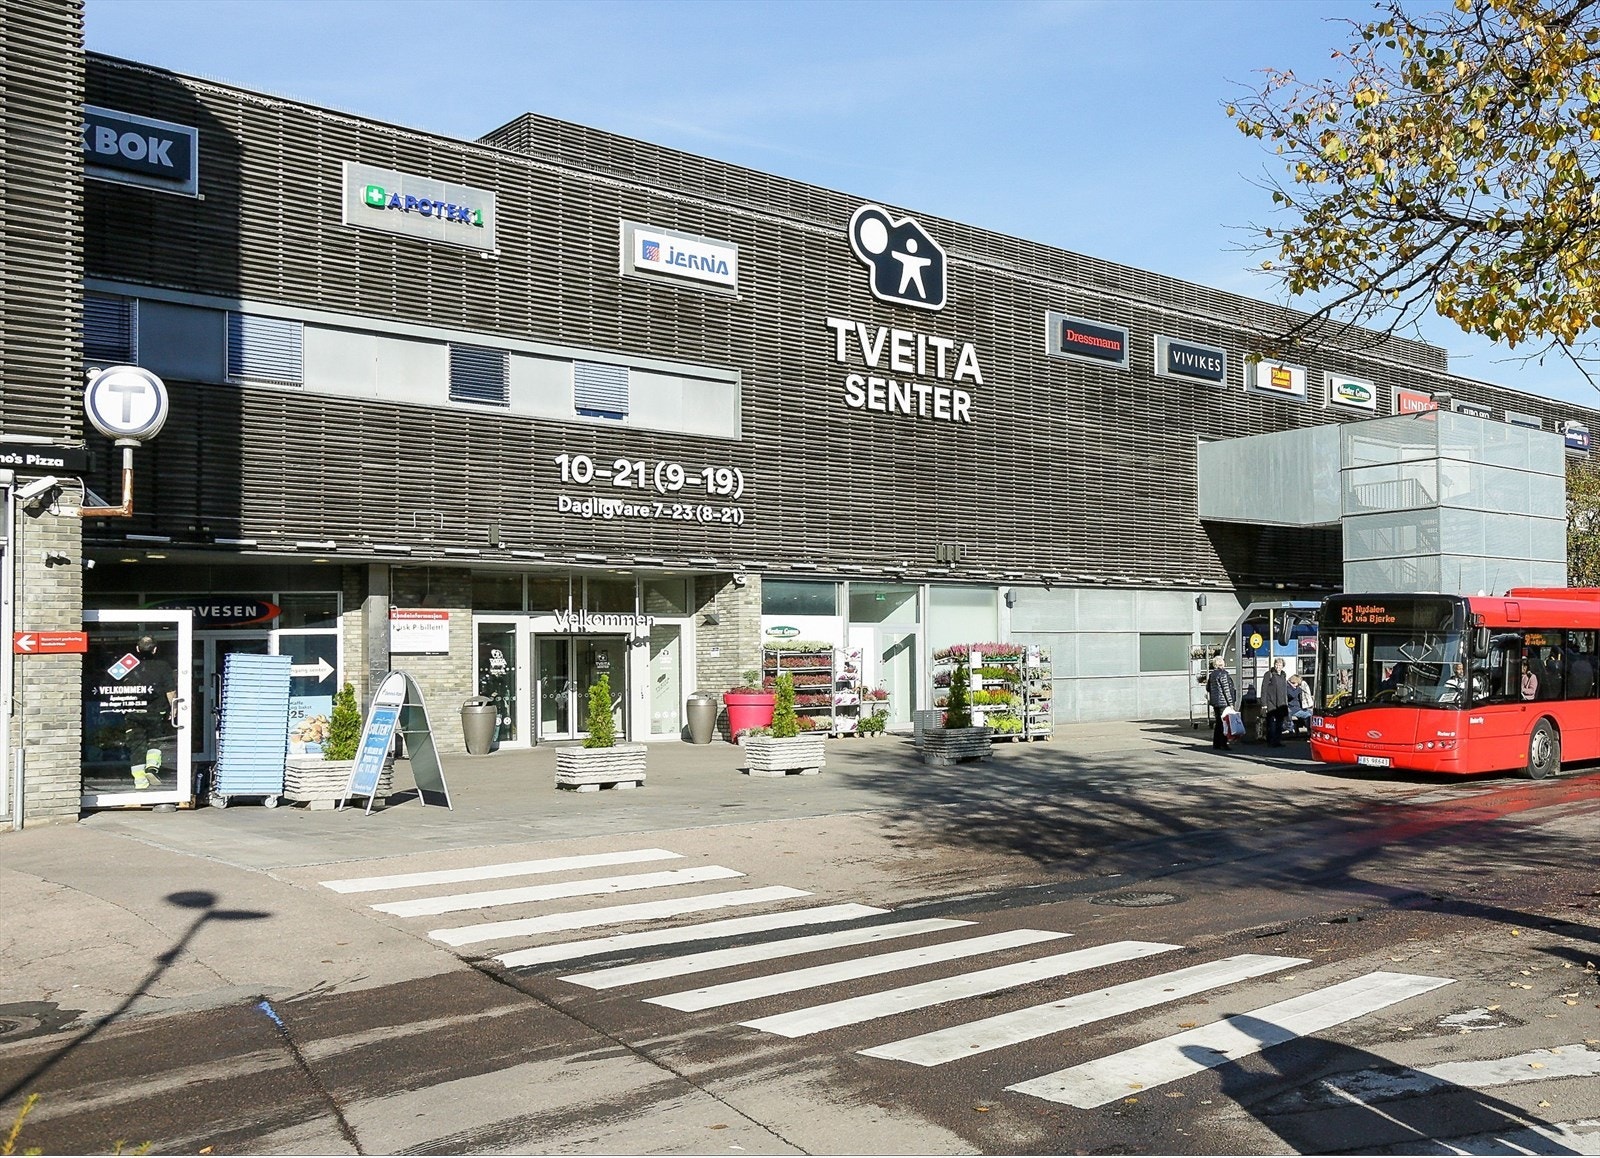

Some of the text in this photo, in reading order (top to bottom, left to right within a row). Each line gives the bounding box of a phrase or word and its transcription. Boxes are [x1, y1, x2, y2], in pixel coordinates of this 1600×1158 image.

[387, 192, 471, 223] APOTEK
[827, 317, 984, 385] TVEITA
[1066, 329, 1121, 351] Dressmann
[1172, 350, 1221, 372] VIVIKES
[108, 384, 146, 423] T
[845, 374, 971, 423] SENTER
[26, 454, 64, 467] Pizza
[557, 495, 650, 519] Dagligvare
[554, 608, 656, 627] Velkommen
[1341, 606, 1353, 623] 58
[1355, 605, 1385, 615] Nydalen
[1369, 614, 1396, 624] Bjerke
[99, 685, 147, 695] VELKOMMEN
